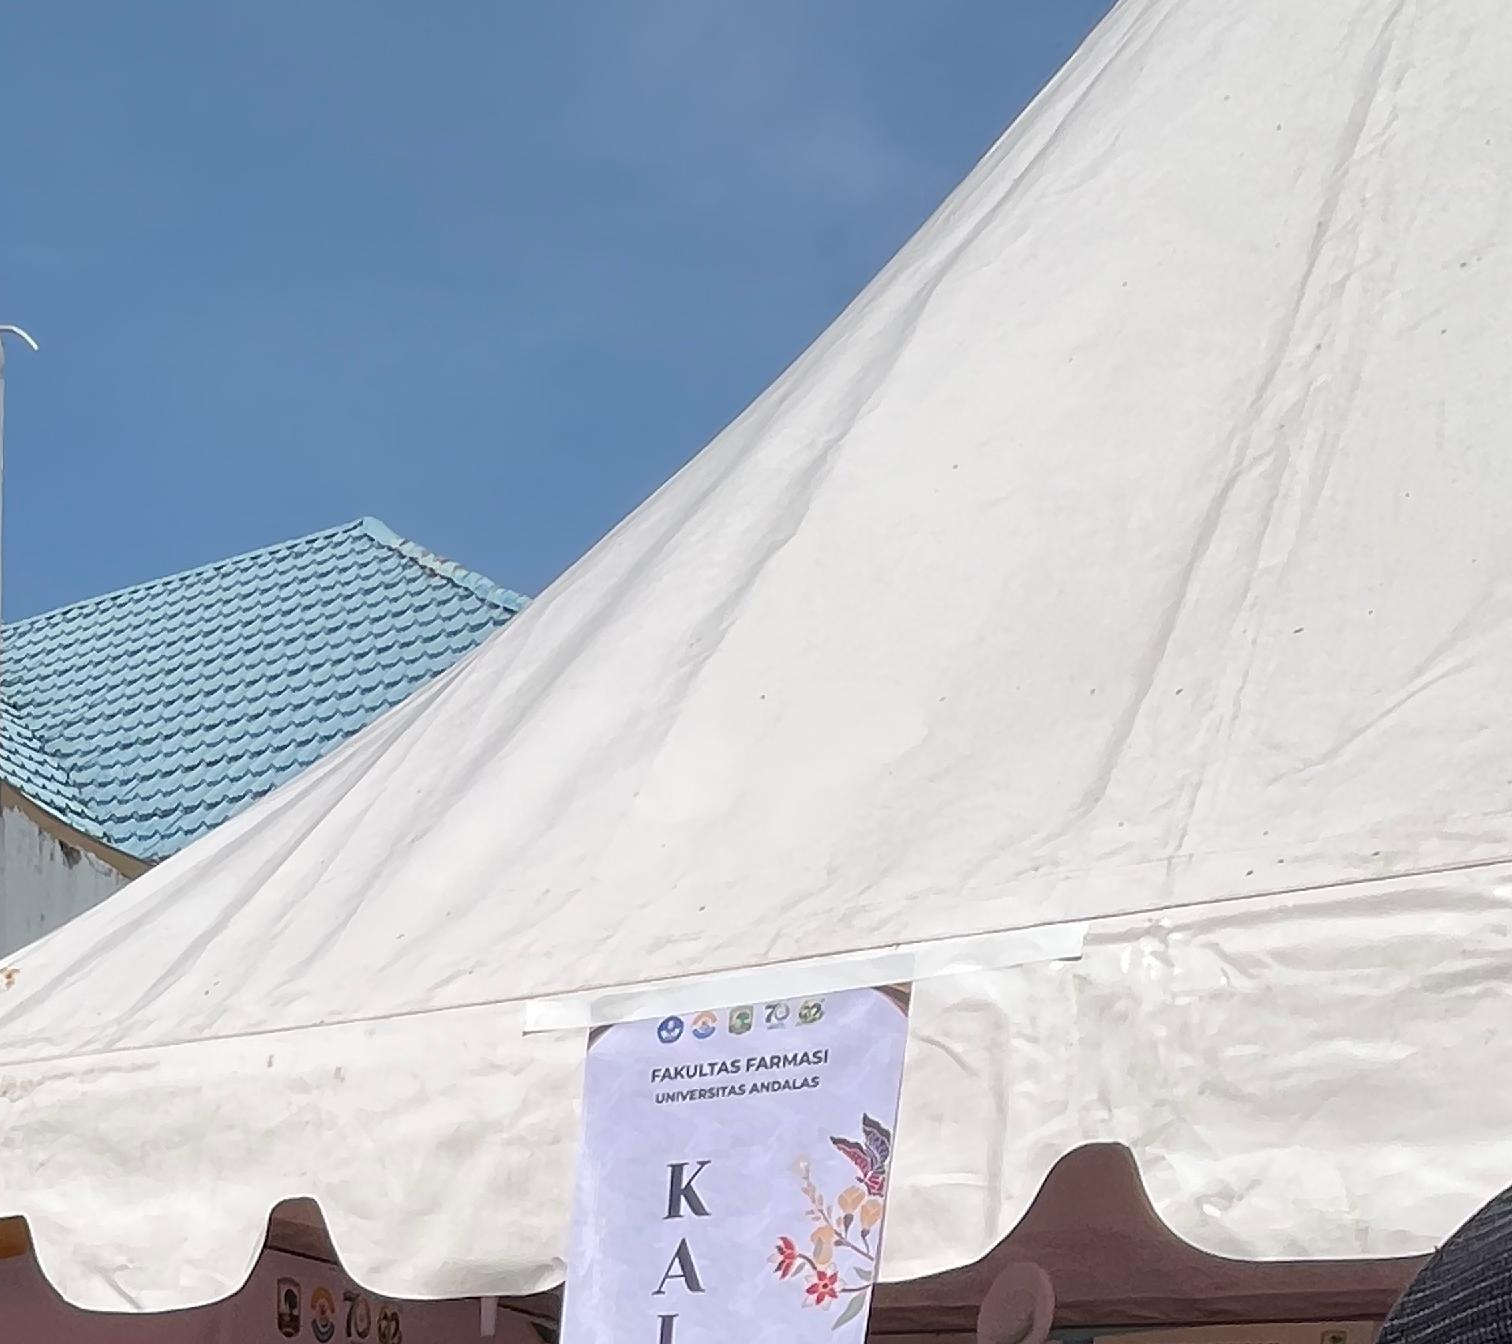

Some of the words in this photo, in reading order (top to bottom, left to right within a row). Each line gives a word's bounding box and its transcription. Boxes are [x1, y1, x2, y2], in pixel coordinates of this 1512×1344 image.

[651, 1058, 741, 1083] FAKULTAS
[746, 1048, 830, 1073] FARMASI
[655, 1083, 746, 1104] UNIVERSITAS
[748, 1076, 820, 1095] ANDALAS
